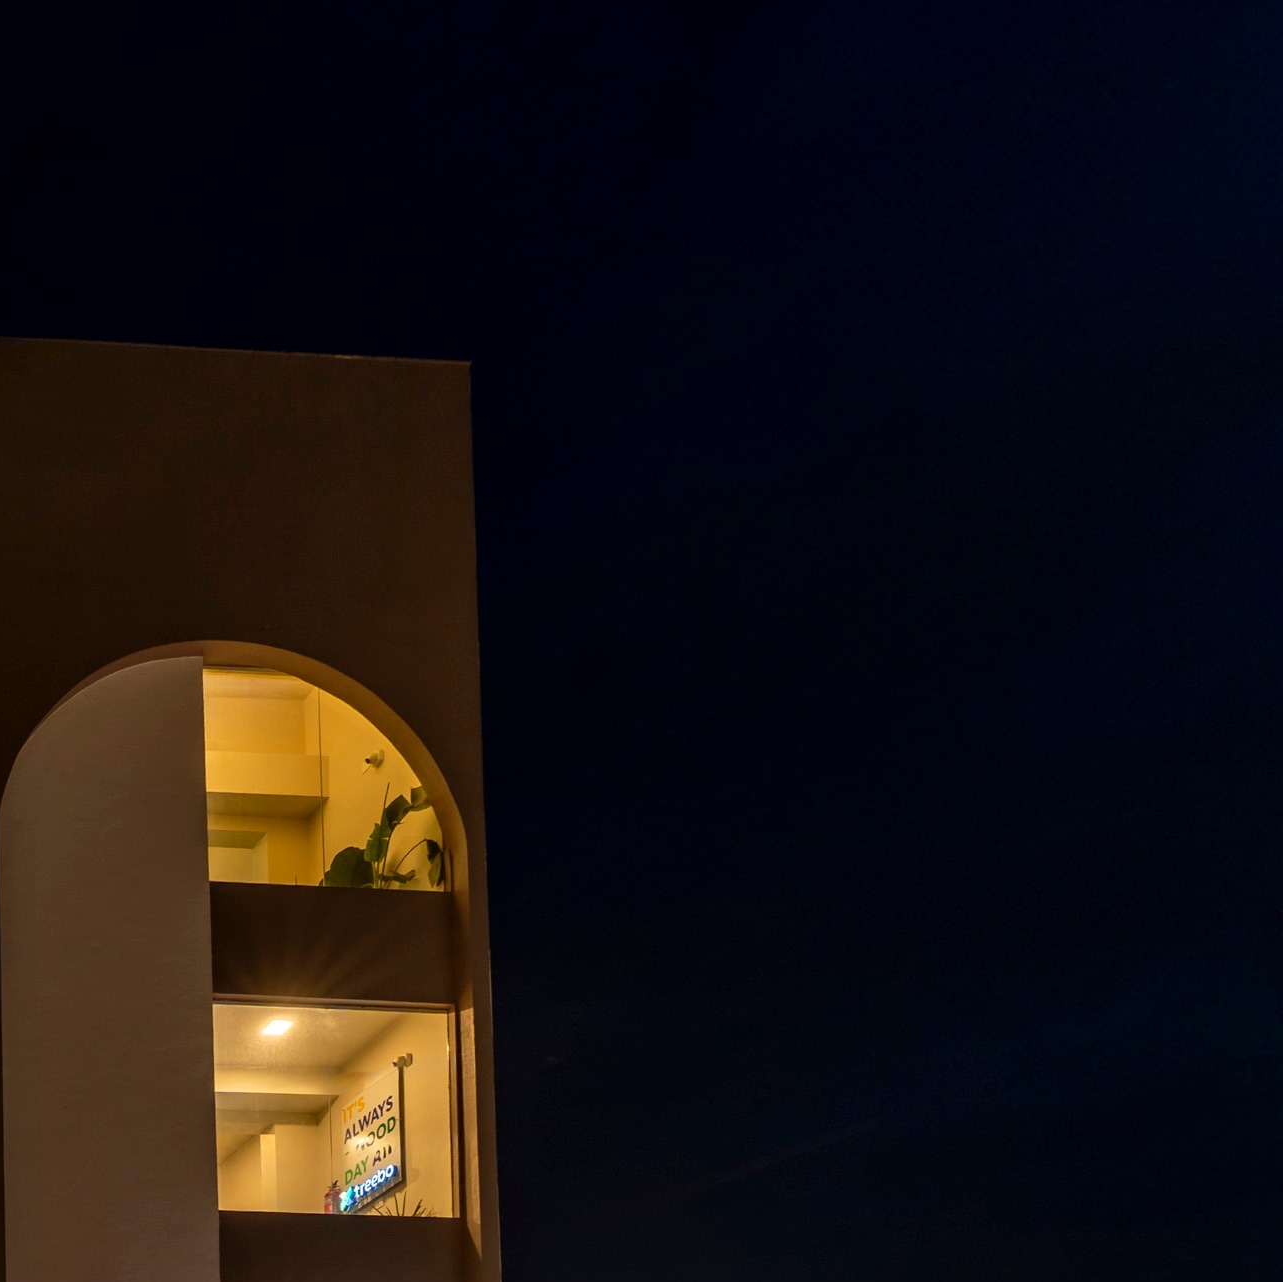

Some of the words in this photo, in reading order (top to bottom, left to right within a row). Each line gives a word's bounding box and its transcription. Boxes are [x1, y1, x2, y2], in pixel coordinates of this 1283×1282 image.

[342, 1096, 365, 1123] IT'S
[344, 1095, 393, 1144] ALWAYS
[344, 1156, 369, 1185] DAY
[353, 1164, 395, 1199] treebo
